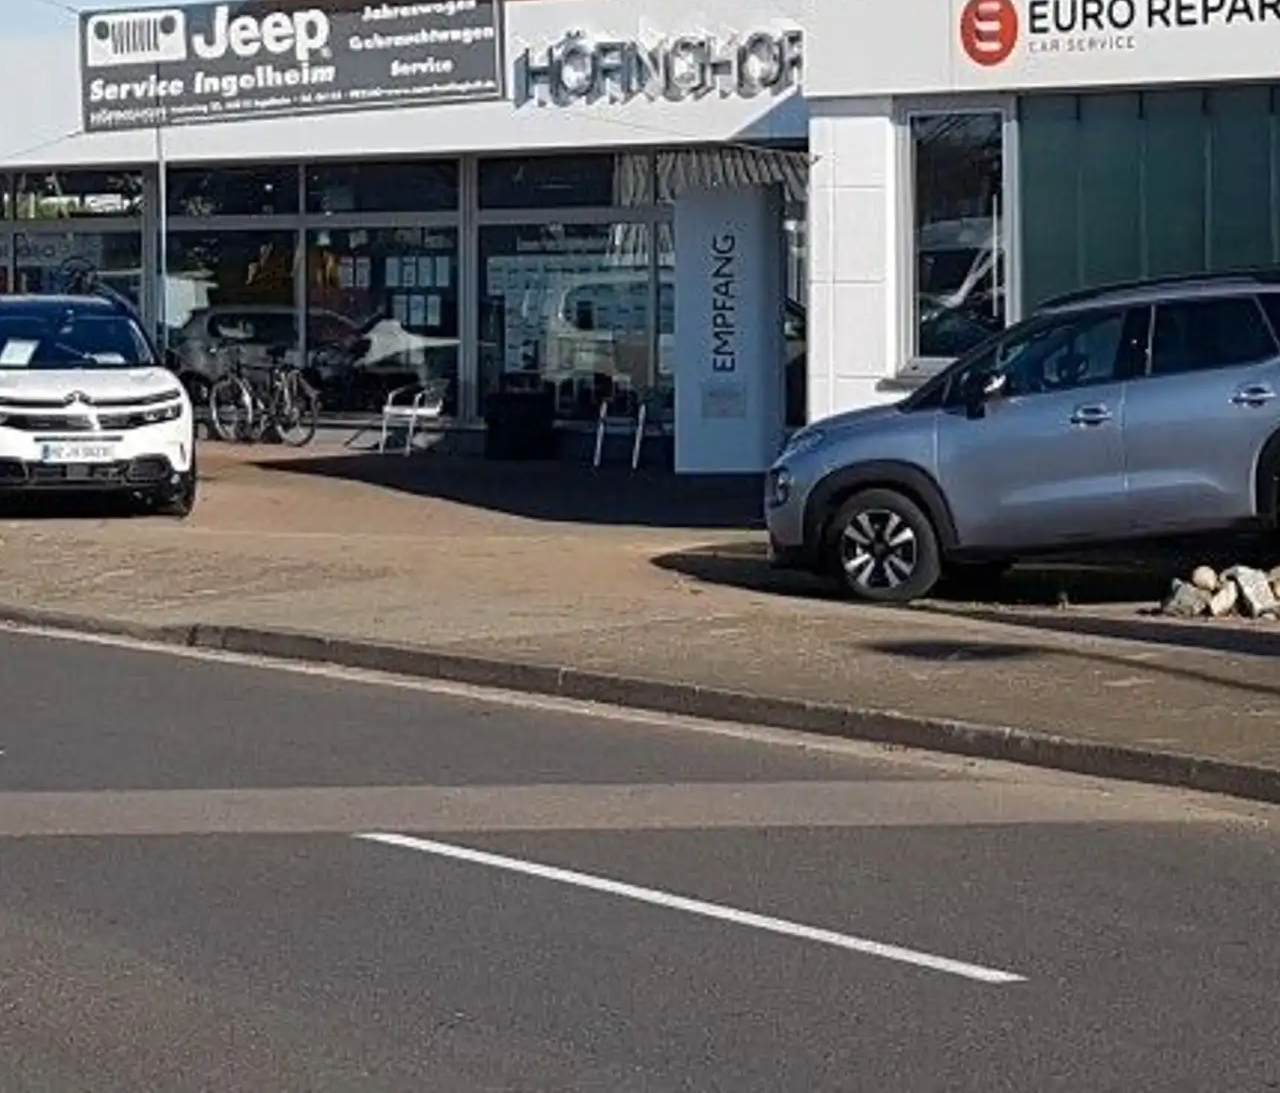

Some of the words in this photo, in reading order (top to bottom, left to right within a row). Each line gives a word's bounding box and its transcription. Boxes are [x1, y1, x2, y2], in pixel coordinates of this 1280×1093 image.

[191, 4, 330, 61] Jeep
[1028, 41, 1061, 54] CAR
[1066, 36, 1136, 52] SERVICE
[89, 74, 185, 102] Service
[193, 62, 337, 97] Ingelheim
[390, 56, 454, 77] Service
[713, 234, 736, 373] EMPFANG
